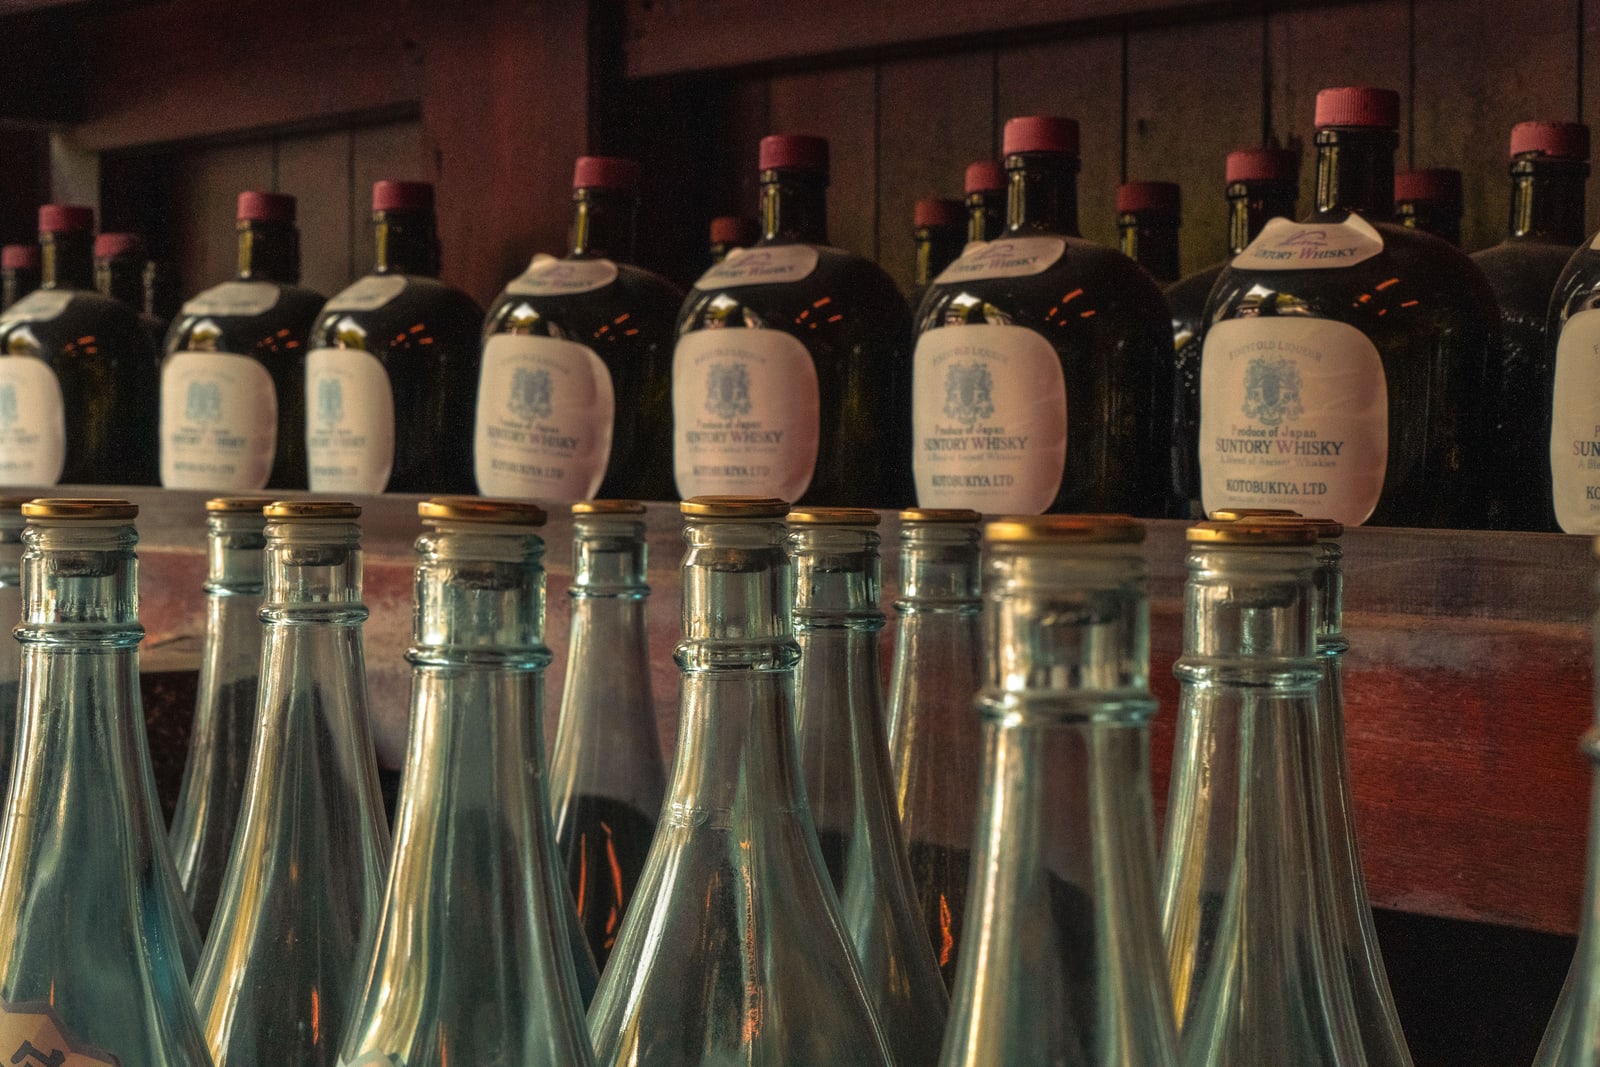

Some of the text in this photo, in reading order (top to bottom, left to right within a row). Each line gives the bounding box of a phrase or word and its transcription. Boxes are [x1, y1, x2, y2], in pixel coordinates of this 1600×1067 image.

[1300, 246, 1357, 259] WHISKY
[1232, 424, 1317, 439] Produce of Japan
[1215, 438, 1344, 456] SUNTORY WHISKY
[1573, 440, 1600, 457] SUN
[1226, 479, 1328, 496] KOTOBUKIYA LTD
